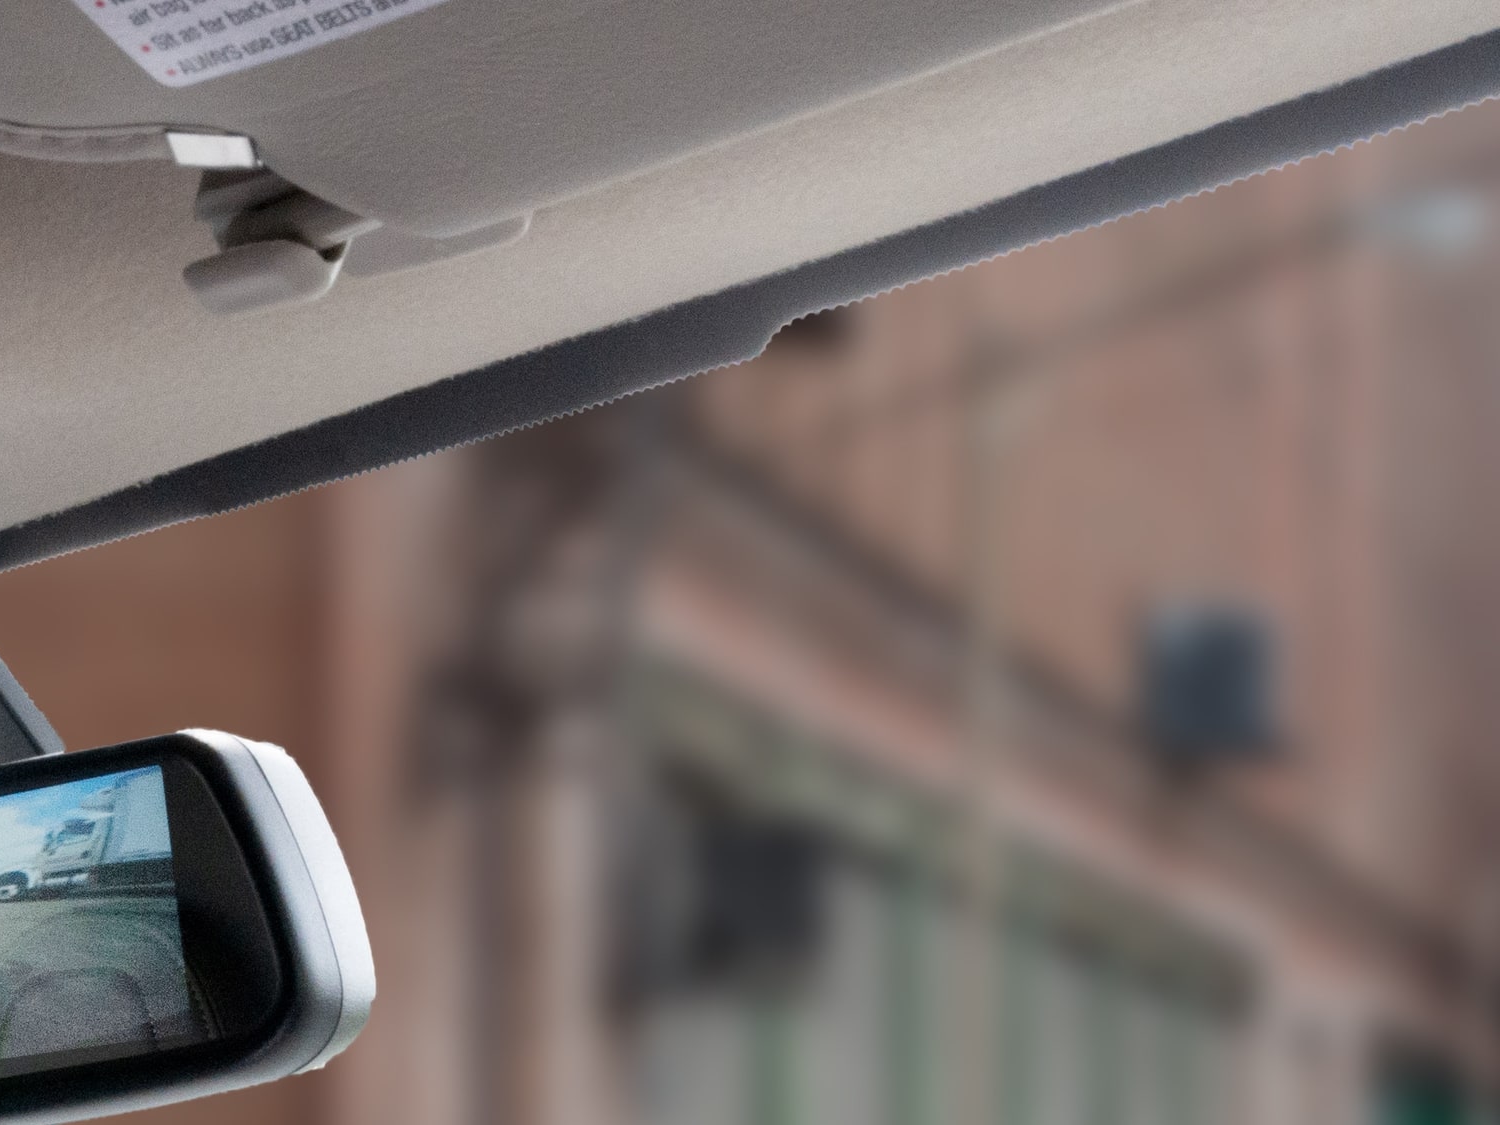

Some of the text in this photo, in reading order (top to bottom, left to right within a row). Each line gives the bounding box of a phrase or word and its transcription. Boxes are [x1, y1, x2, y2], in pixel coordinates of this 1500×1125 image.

[129, 0, 190, 26] air bag
[151, 32, 182, 51] Sit
[178, 26, 202, 43] as
[198, 16, 226, 34] far
[223, 0, 274, 27] back
[178, 43, 244, 75] ALWAYS
[241, 36, 275, 56] use
[270, 17, 316, 46] SEAT
[313, 0, 373, 31] BELTS
